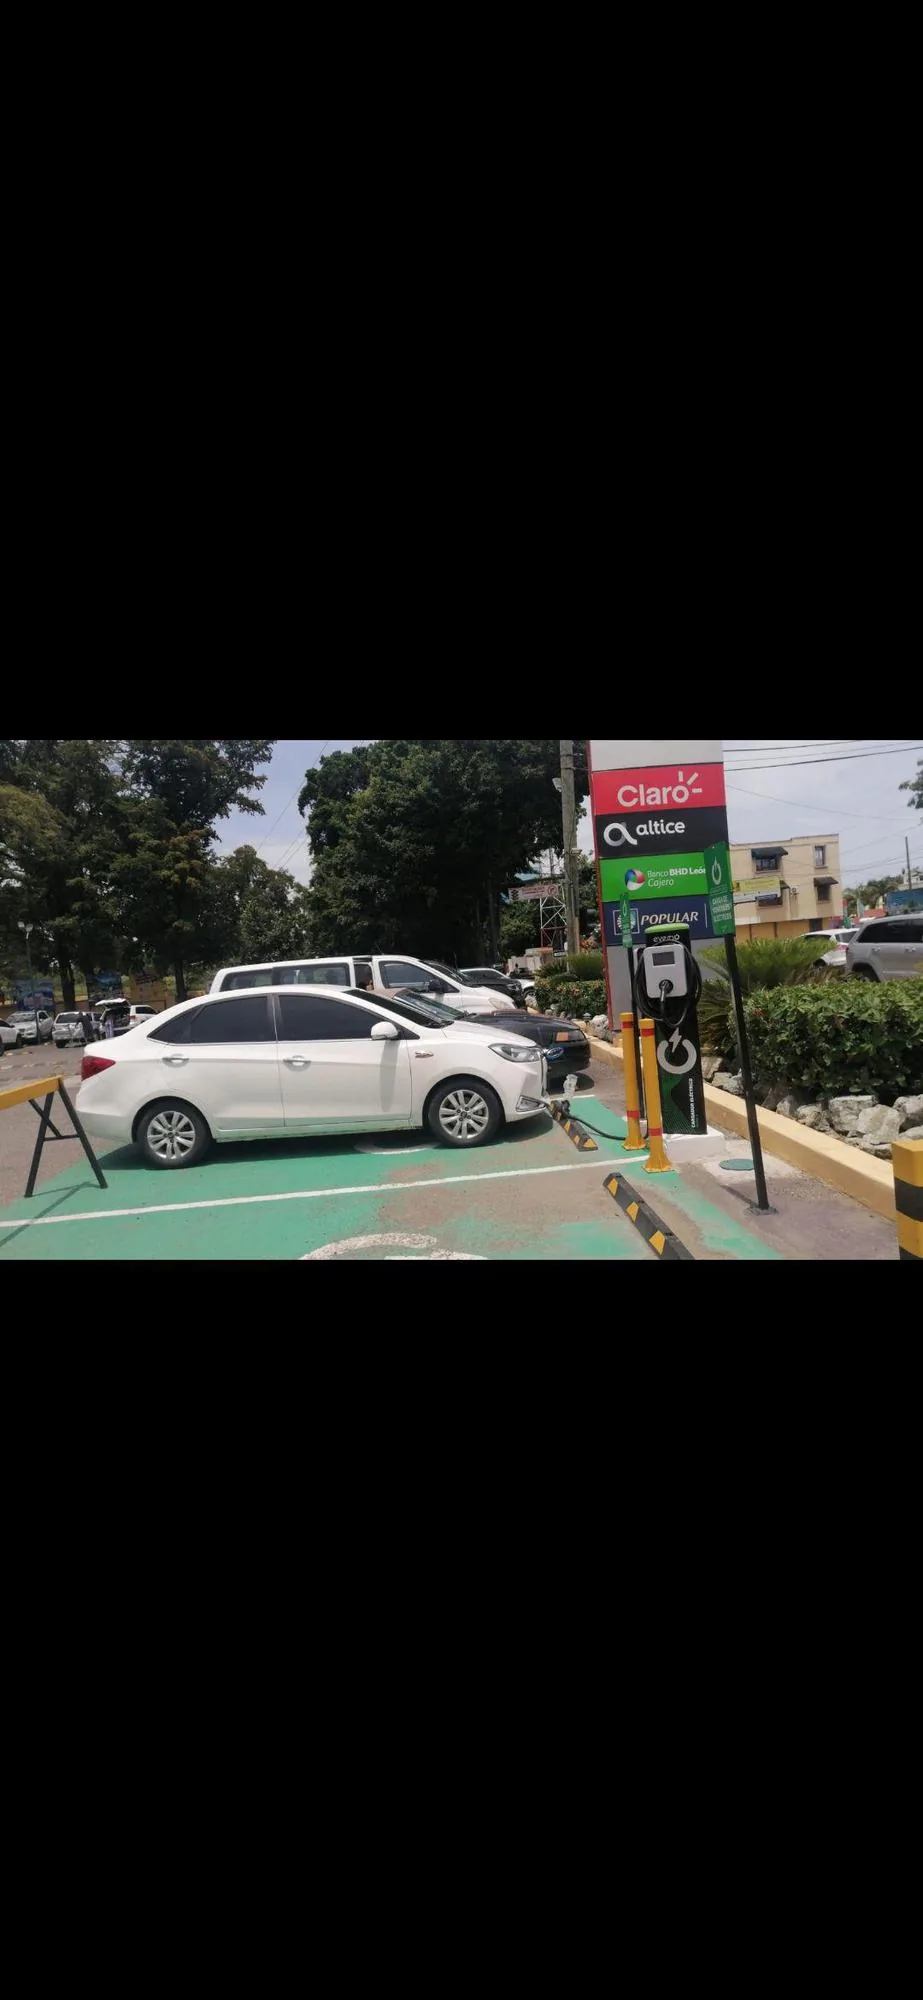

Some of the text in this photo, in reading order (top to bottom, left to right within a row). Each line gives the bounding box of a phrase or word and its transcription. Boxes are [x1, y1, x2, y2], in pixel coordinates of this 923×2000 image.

[617, 783, 690, 808] Claro
[636, 819, 686, 836] altice
[647, 870, 668, 878] Banco
[669, 868, 688, 876] BHD
[648, 879, 674, 888] Cajero
[640, 911, 699, 925] POPULAR
